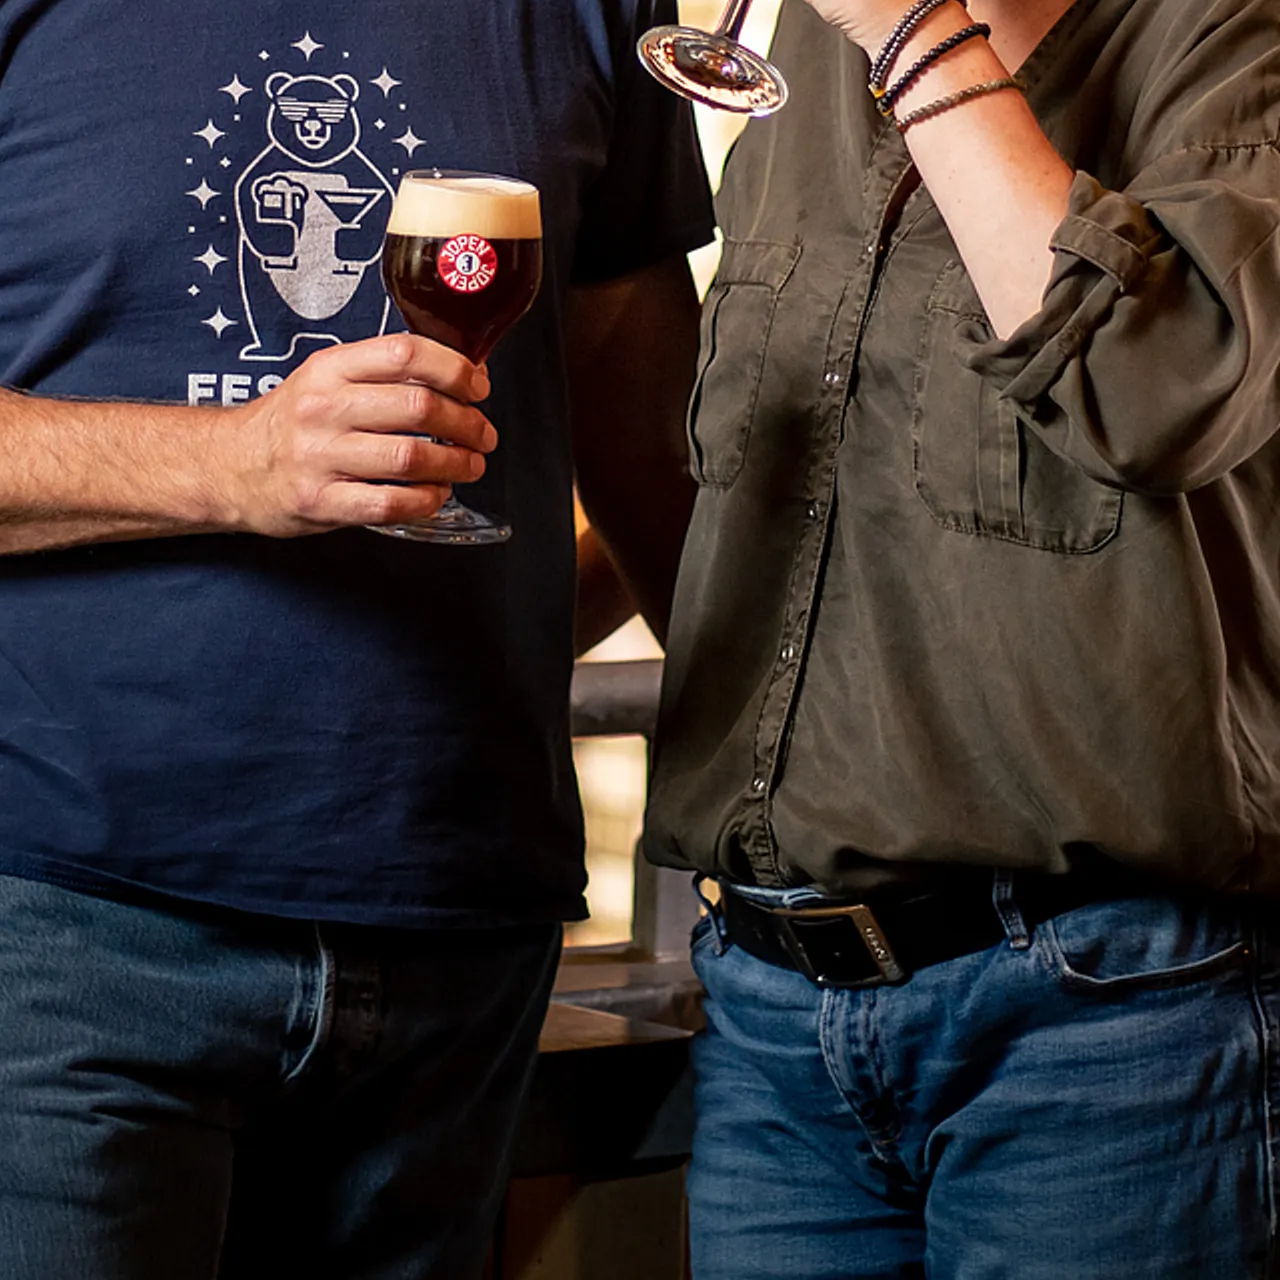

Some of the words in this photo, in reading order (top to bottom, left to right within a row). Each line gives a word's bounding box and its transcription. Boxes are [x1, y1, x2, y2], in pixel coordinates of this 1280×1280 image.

[441, 235, 491, 262] JOPEN
[444, 264, 495, 291] JOPEN
[187, 373, 285, 407] FES
